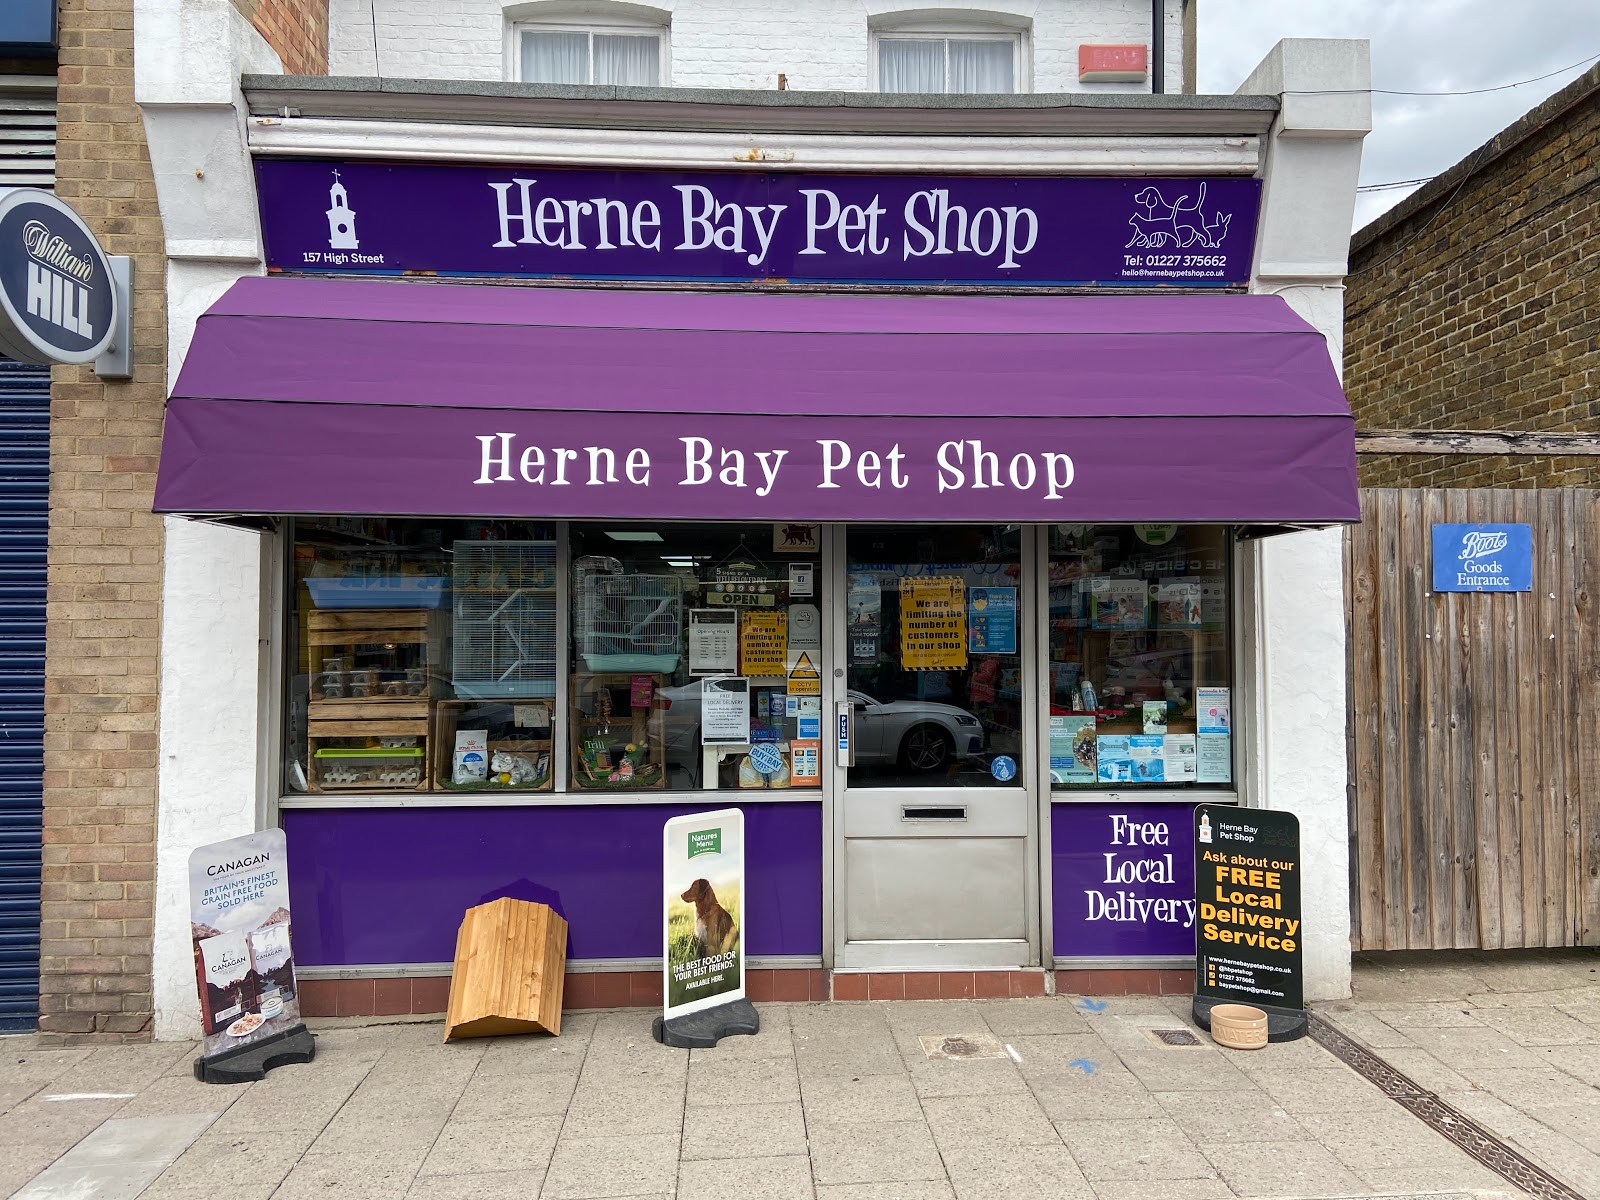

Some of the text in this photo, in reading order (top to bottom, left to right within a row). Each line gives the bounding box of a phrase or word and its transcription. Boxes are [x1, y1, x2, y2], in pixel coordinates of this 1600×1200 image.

[488, 179, 1038, 268] Herne Bay Pet Shop
[23, 220, 93, 282] William
[303, 252, 385, 265] 157 High Street
[1124, 255, 1227, 266] Tel: 01227 375662
[1122, 269, 1225, 278] hello@hernebaypetshop.co.uk
[27, 261, 93, 340] HILL
[473, 433, 1075, 500] Herne Bay Pet Shop
[1458, 531, 1507, 560] Boots
[1464, 560, 1502, 573] Goods
[1457, 572, 1510, 586] Entrance
[722, 594, 759, 605] OPEN
[916, 600, 931, 608] We
[906, 610, 962, 619] limiting the
[908, 621, 945, 629] number
[908, 631, 959, 640] customers
[906, 641, 961, 650] in our shop
[586, 740, 605, 749] Trill
[751, 748, 767, 760] BUY
[767, 756, 781, 769] BAY
[1109, 815, 1168, 846] Free
[1219, 823, 1258, 834] Herne Bay
[1219, 831, 1255, 843] Pet Shop
[691, 833, 718, 843] Natures
[696, 840, 714, 848] Menu
[207, 852, 270, 876] CANAGAN
[1103, 853, 1175, 884] Local
[1203, 850, 1294, 871] Ask about our
[204, 879, 245, 897] BRITAIN'S
[247, 871, 276, 885] FINEST
[1216, 865, 1281, 890] FREE
[201, 878, 279, 906] GRAIN FREE FOOD
[217, 890, 265, 910] SOLD HERE
[1215, 885, 1282, 910] Local
[1084, 890, 1196, 928] Delivery
[1200, 903, 1300, 937] Delivery
[1203, 923, 1297, 953] Service
[256, 948, 283, 961] CANAGAN
[673, 950, 736, 974] THE BEST FOOD FOR
[211, 956, 246, 973] CANAGAN
[674, 959, 735, 982] YOUR BEST FRIENDS.
[1208, 956, 1292, 974] www.hernebaypetshop.co.uk
[1218, 965, 1254, 976] @hbpetshop
[685, 974, 725, 990] AVAILABLE HERE.
[1218, 973, 1234, 981] 01227
[1218, 982, 1284, 997] baypetshop@gmail.com
